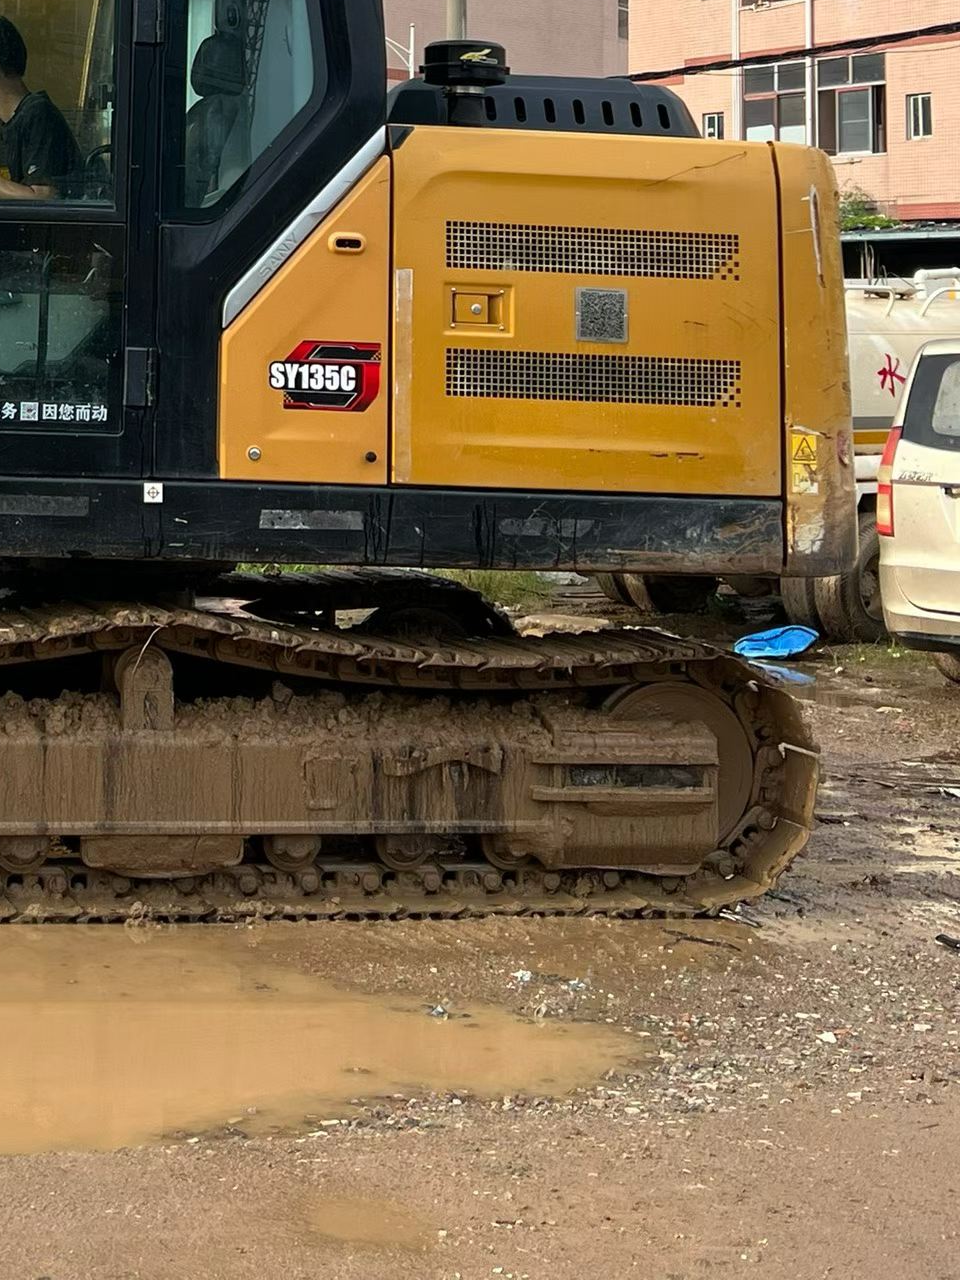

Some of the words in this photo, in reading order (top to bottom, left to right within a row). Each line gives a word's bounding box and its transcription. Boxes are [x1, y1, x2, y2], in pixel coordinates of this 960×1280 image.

[259, 231, 298, 278] SANY
[270, 362, 356, 391] SY135C
[877, 353, 906, 397] 水
[42, 402, 108, 422] 因您而动
